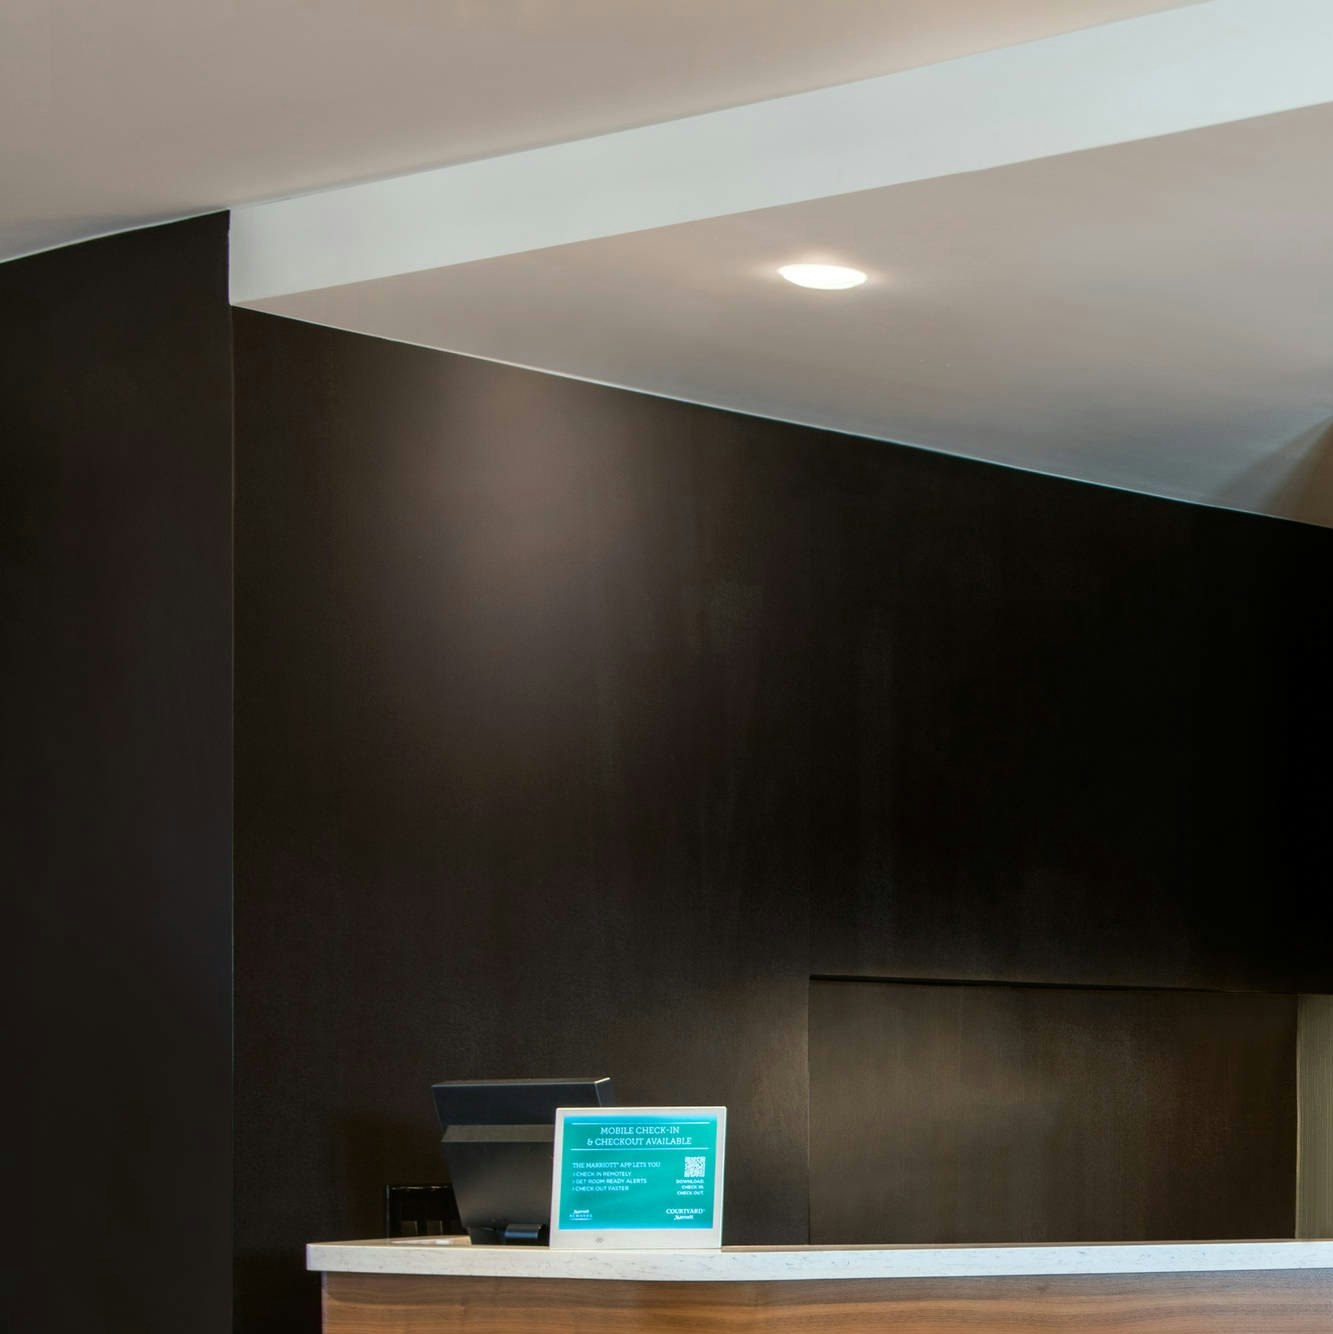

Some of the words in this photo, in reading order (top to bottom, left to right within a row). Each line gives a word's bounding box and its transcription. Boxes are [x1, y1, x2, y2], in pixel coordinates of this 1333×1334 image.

[600, 1127, 634, 1135] MOBILE
[636, 1126, 680, 1134] CHECK-IN
[587, 1138, 593, 1146] &
[595, 1138, 644, 1146] CHECKOUT
[646, 1137, 692, 1145] AVAILABLE
